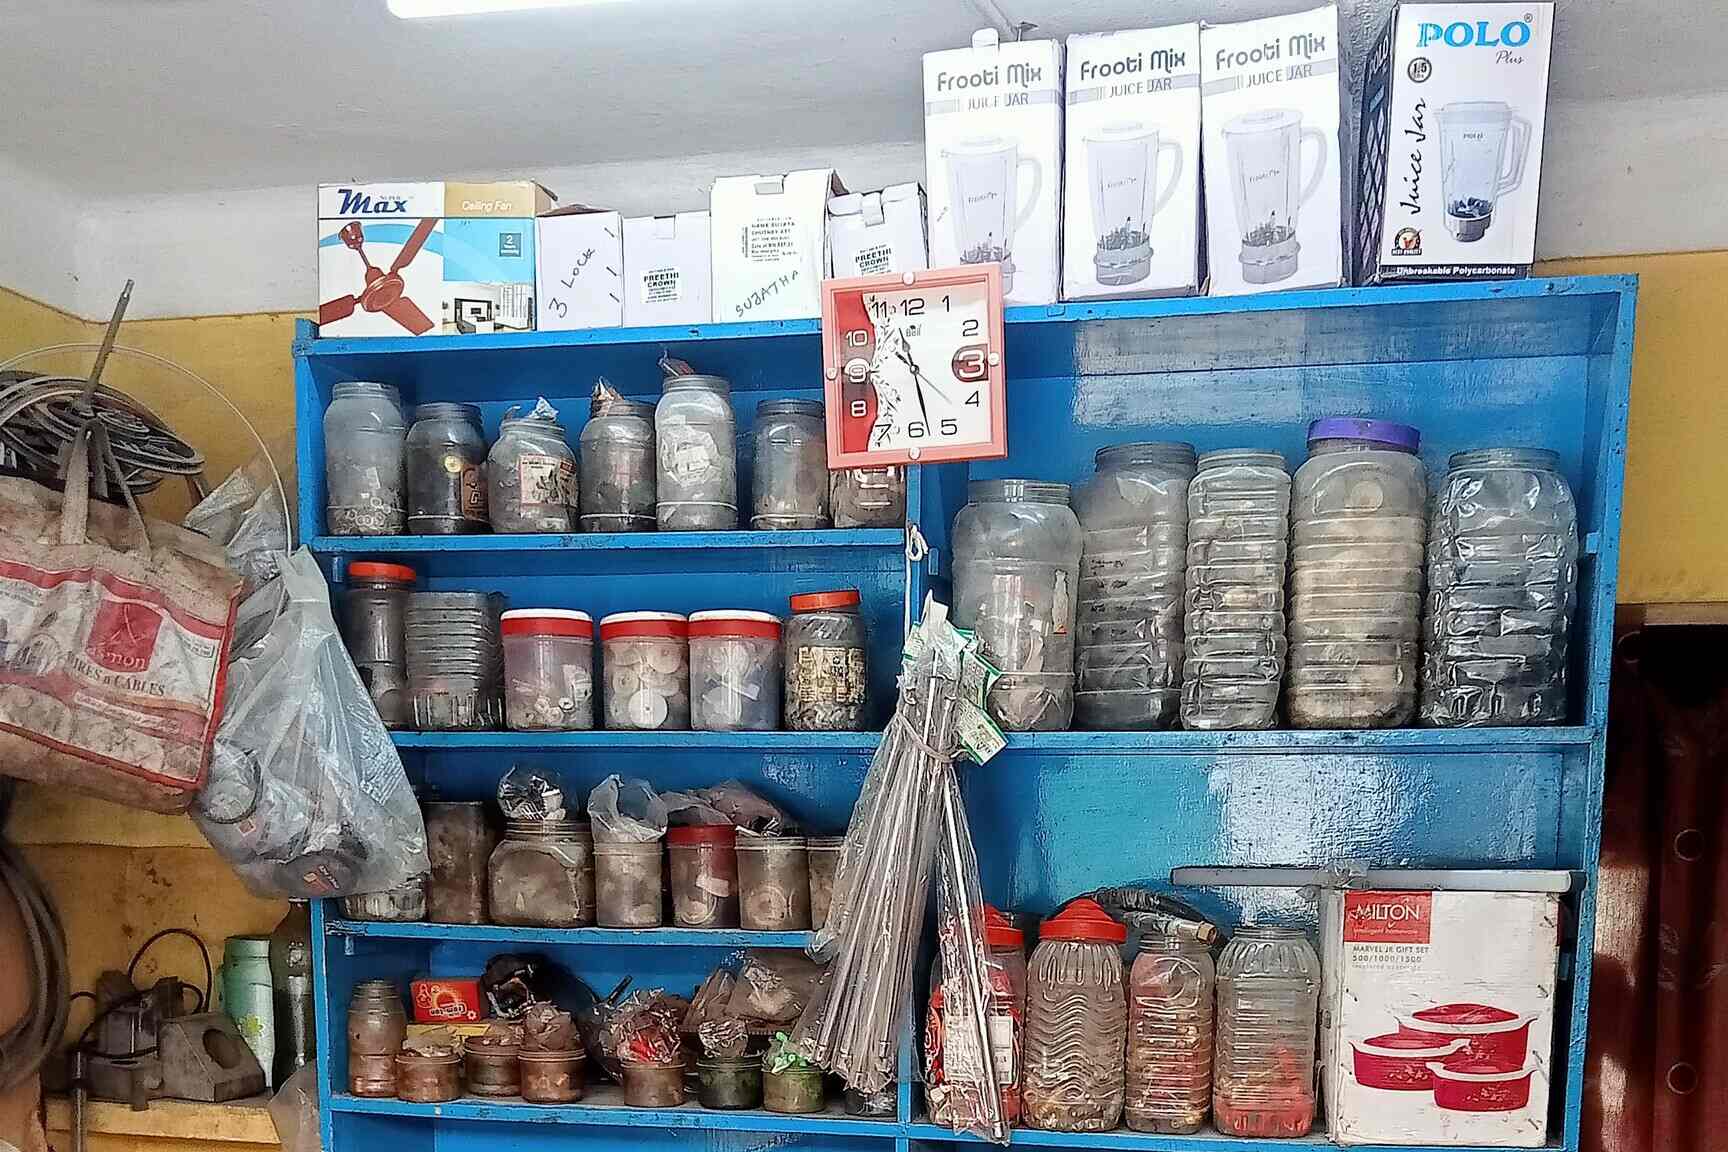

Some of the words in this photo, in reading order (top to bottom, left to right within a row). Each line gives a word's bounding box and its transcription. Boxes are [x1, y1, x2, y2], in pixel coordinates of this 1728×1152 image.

[1416, 21, 1531, 48] POLO
[1217, 38, 1280, 70] Frooti
[1289, 32, 1325, 59] Mix
[1495, 50, 1524, 64] Plus
[1081, 53, 1142, 80] Frooti
[1150, 48, 1186, 73] Mix
[937, 66, 999, 91] Frooti
[1007, 62, 1042, 88] Mix
[1248, 69, 1283, 88] JUICE
[1287, 64, 1312, 80] JAR
[1109, 82, 1143, 98] JUICE
[1147, 78, 1172, 92] JAR
[1006, 92, 1029, 107] JAR
[1405, 98, 1426, 142] Jar
[1400, 150, 1422, 215] Juice
[337, 188, 408, 214] Max
[462, 200, 492, 213] Ceiling
[494, 199, 512, 212] Fan
[859, 256, 889, 269] CROWN
[1397, 266, 1451, 275] Unbreakable
[1453, 266, 1516, 276] Polycarbonate
[644, 272, 680, 282] PREETHI
[647, 280, 676, 288] CROWN
[871, 301, 887, 318] 11
[900, 298, 925, 316] 12
[942, 295, 950, 312] 1
[962, 319, 979, 337] 2
[846, 330, 868, 346] 10
[959, 350, 985, 379] 3
[849, 366, 867, 383] 9
[965, 391, 980, 407] 4
[851, 400, 867, 417] 8
[875, 423, 892, 441] 7
[908, 421, 925, 438] 6
[940, 418, 958, 435] 5
[113, 675, 166, 697] CABLES
[1354, 903, 1420, 920] MILTON
[1352, 945, 1382, 953] MARVEL
[1415, 946, 1429, 954] SET
